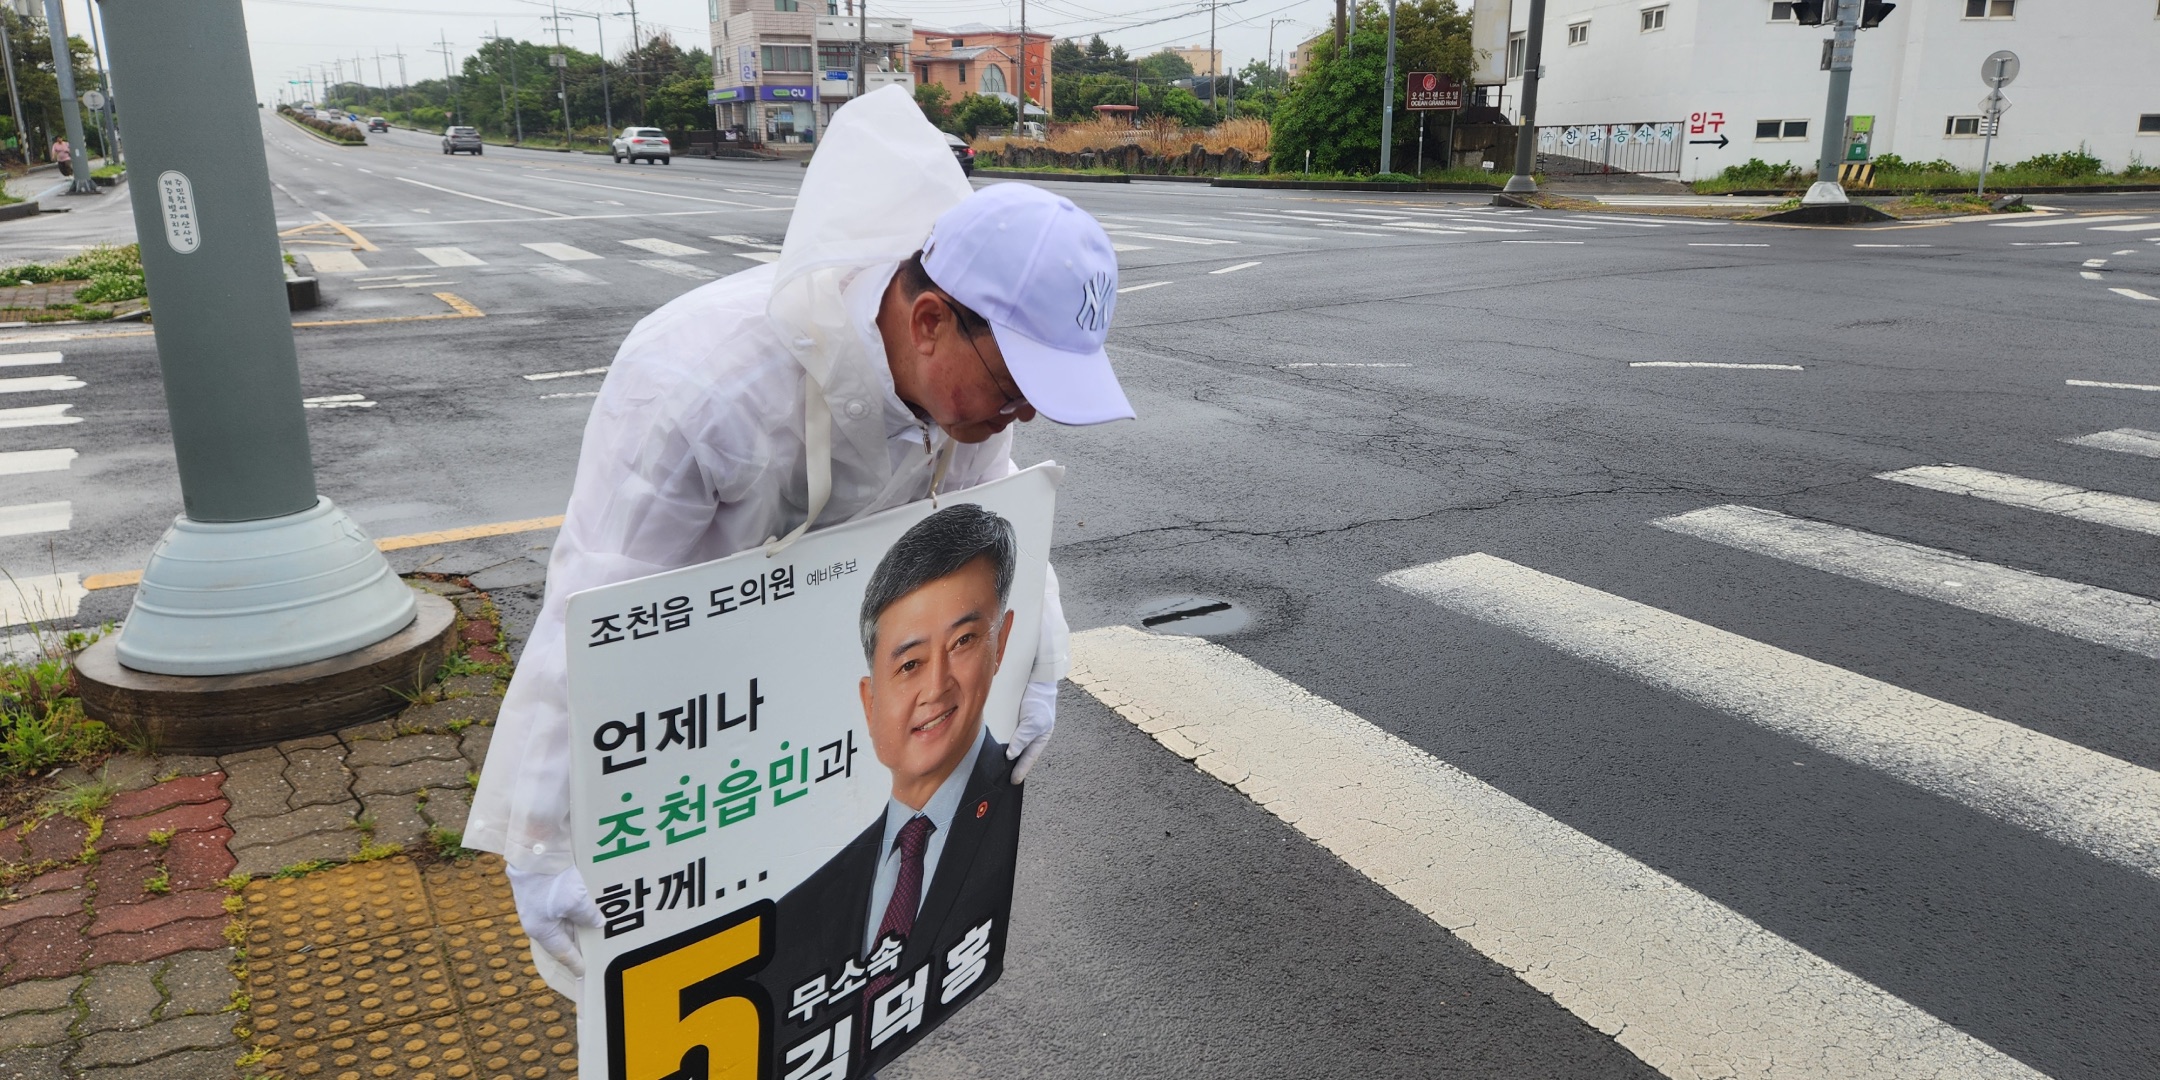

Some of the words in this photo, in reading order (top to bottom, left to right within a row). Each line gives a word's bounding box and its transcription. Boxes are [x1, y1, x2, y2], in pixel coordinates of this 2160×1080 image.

[791, 88, 806, 97] CU
[1690, 112, 1726, 134] 입구
[588, 595, 694, 648] 조천읍
[706, 564, 796, 620] 도의원
[806, 557, 858, 588] 예비후보
[593, 677, 765, 776] 언제나
[592, 730, 858, 864] 조천읍민과
[621, 915, 761, 1080] 5
[787, 935, 904, 1022] 무소속
